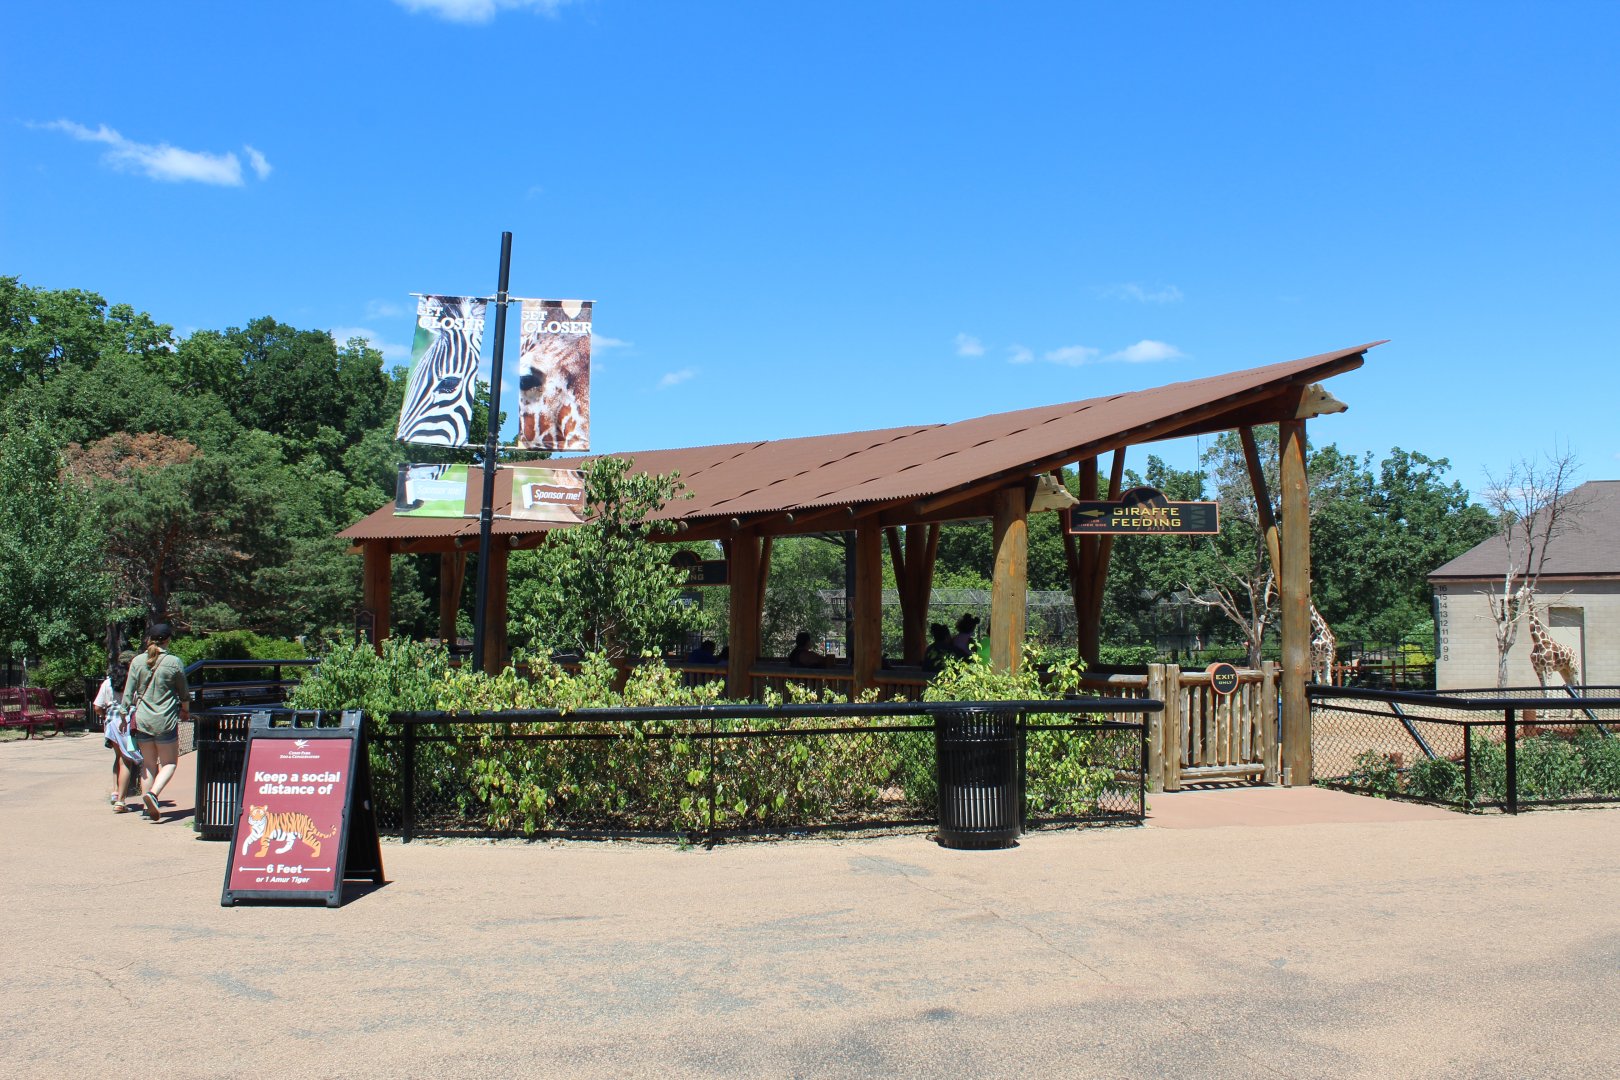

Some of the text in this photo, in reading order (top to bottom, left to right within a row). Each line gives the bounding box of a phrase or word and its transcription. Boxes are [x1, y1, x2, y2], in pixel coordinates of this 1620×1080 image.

[523, 320, 592, 334] CLOSER
[534, 489, 582, 500] Sponsor me!
[1113, 507, 1179, 516] GIRAFFE
[1111, 518, 1181, 527] FEEDING
[254, 771, 341, 784] Keep a social
[259, 784, 333, 794] distance of
[266, 864, 303, 874] 6 Feet
[291, 876, 309, 884] Tiger
